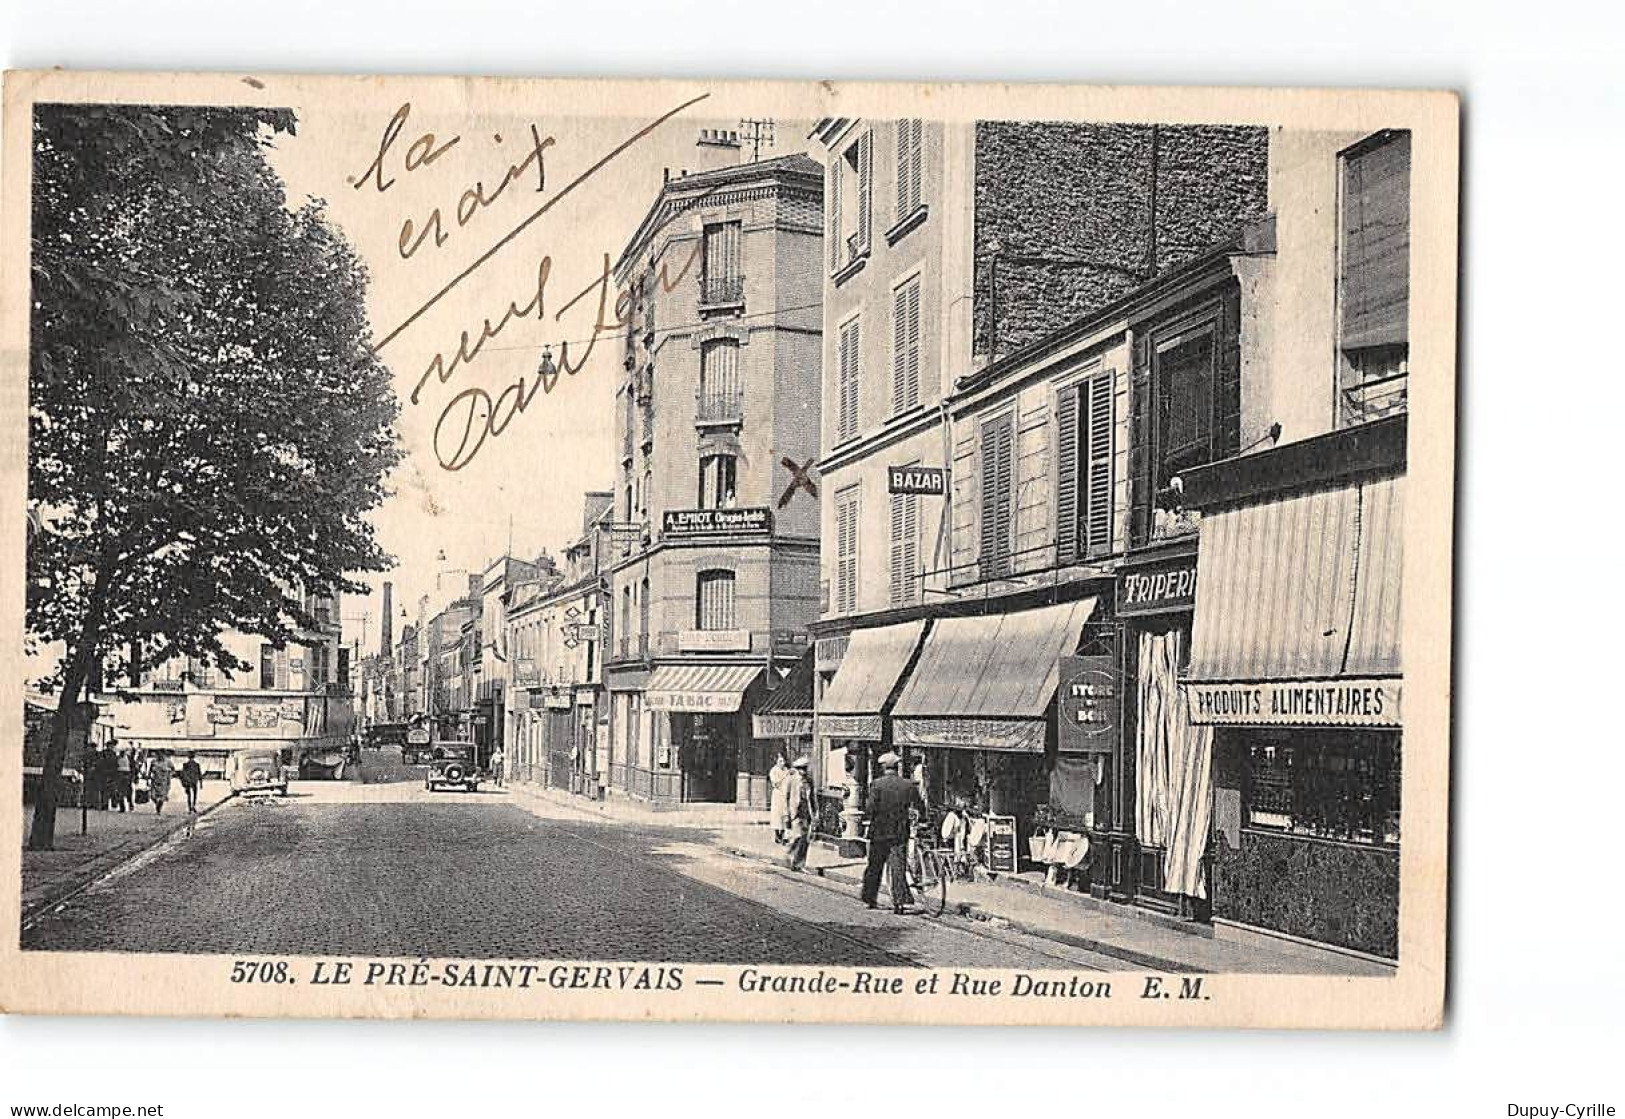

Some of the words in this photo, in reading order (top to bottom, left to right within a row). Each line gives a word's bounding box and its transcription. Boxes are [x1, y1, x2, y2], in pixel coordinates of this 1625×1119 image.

[354, 102, 460, 192] la
[433, 252, 704, 471] Danton
[893, 472, 942, 490] BAZAR
[1124, 568, 1197, 604] TRIPERI
[669, 694, 713, 707] TABAC
[1198, 689, 1262, 715] PRODUITS
[1271, 686, 1384, 716] ALIMENTAIRES
